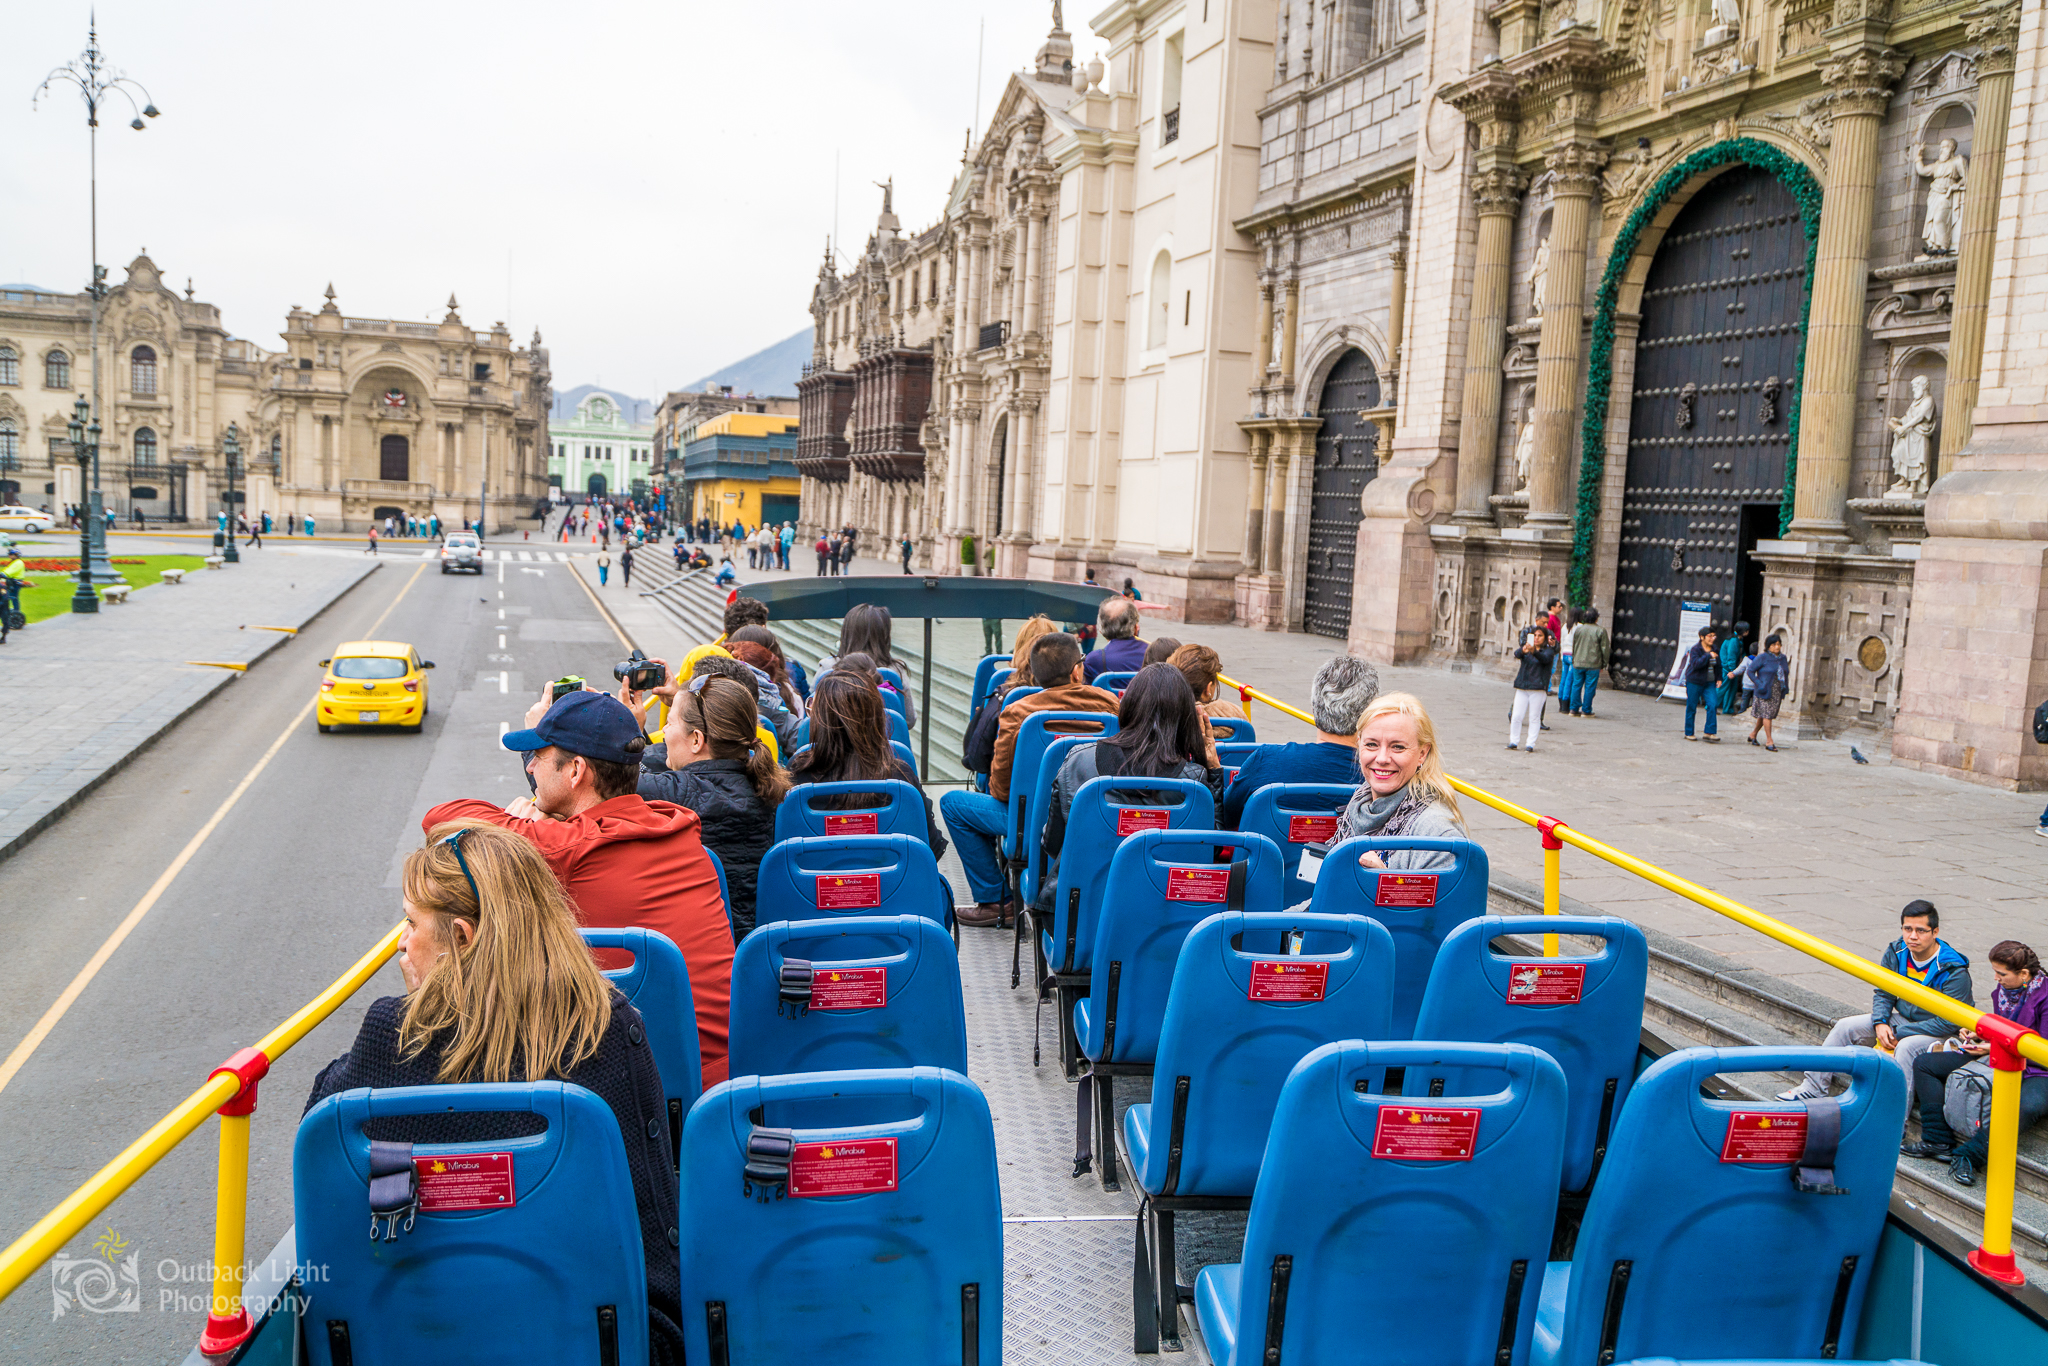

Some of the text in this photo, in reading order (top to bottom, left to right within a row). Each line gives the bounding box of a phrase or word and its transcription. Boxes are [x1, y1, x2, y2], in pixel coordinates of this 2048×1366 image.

[349, 689, 390, 697] PROSEGUR
[1285, 965, 1306, 973] Mirabus
[1543, 968, 1564, 976] Mirabus
[841, 972, 864, 981] Mirabus
[1422, 1112, 1451, 1123] Mirabus
[1772, 1117, 1799, 1127] Mirabus
[835, 1146, 866, 1156] Mirabus
[447, 1160, 480, 1171] Mirabus
